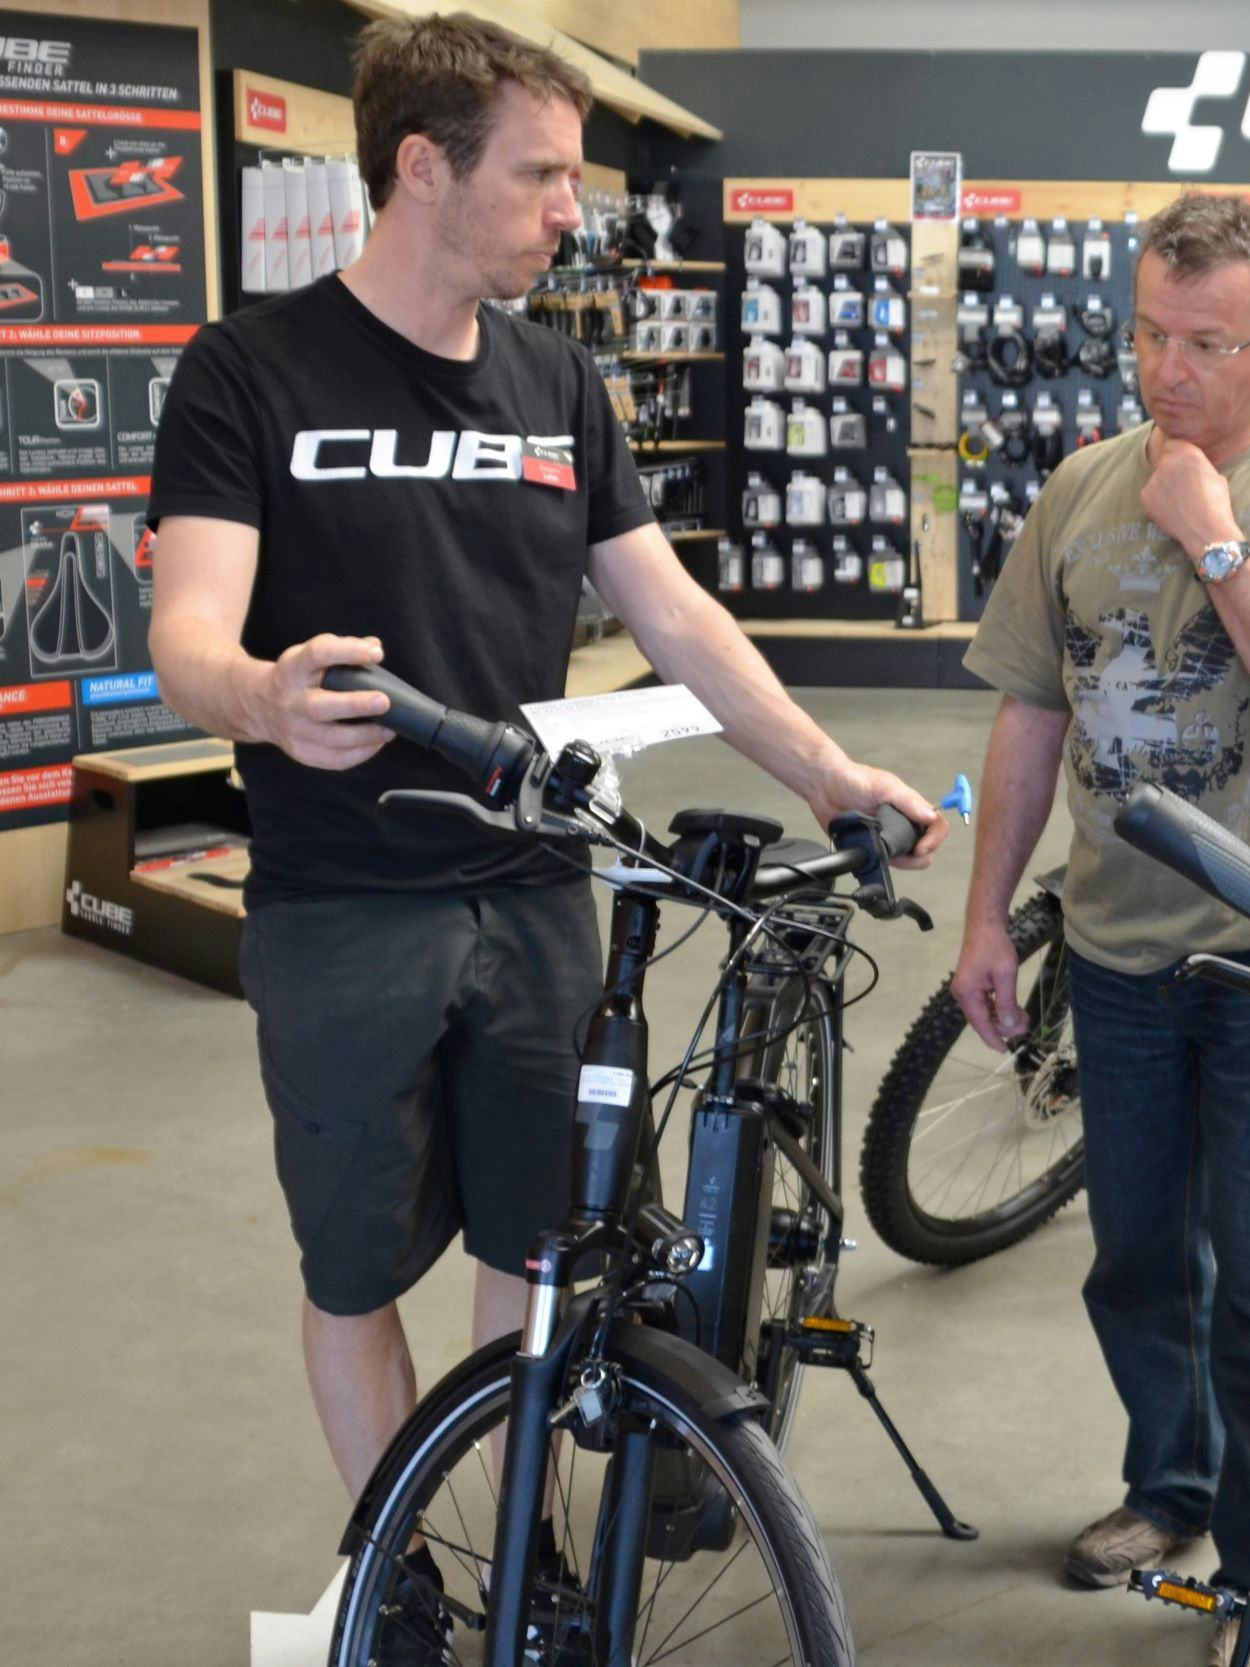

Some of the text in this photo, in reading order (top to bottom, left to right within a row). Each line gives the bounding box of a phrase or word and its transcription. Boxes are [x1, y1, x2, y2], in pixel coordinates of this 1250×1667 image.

[8, 60, 64, 76] FINDER
[52, 79, 93, 95] SATTEL
[95, 82, 108, 96] IN
[109, 84, 117, 96] 3
[118, 84, 178, 100] SCHRITTEN
[47, 105, 73, 118] DEINE
[18, 328, 50, 339] WÄHLE
[52, 329, 80, 339] DEINE
[38, 483, 69, 496] WÄHLE
[71, 482, 104, 494] DEINEN
[90, 676, 136, 693] NATURAL
[137, 674, 153, 689] FIT
[661, 726, 700, 738] 2599
[11, 773, 24, 784] Sie
[27, 773, 39, 782] vor
[42, 769, 60, 779] dem
[23, 781, 37, 792] Sie
[81, 893, 133, 926] CUBE
